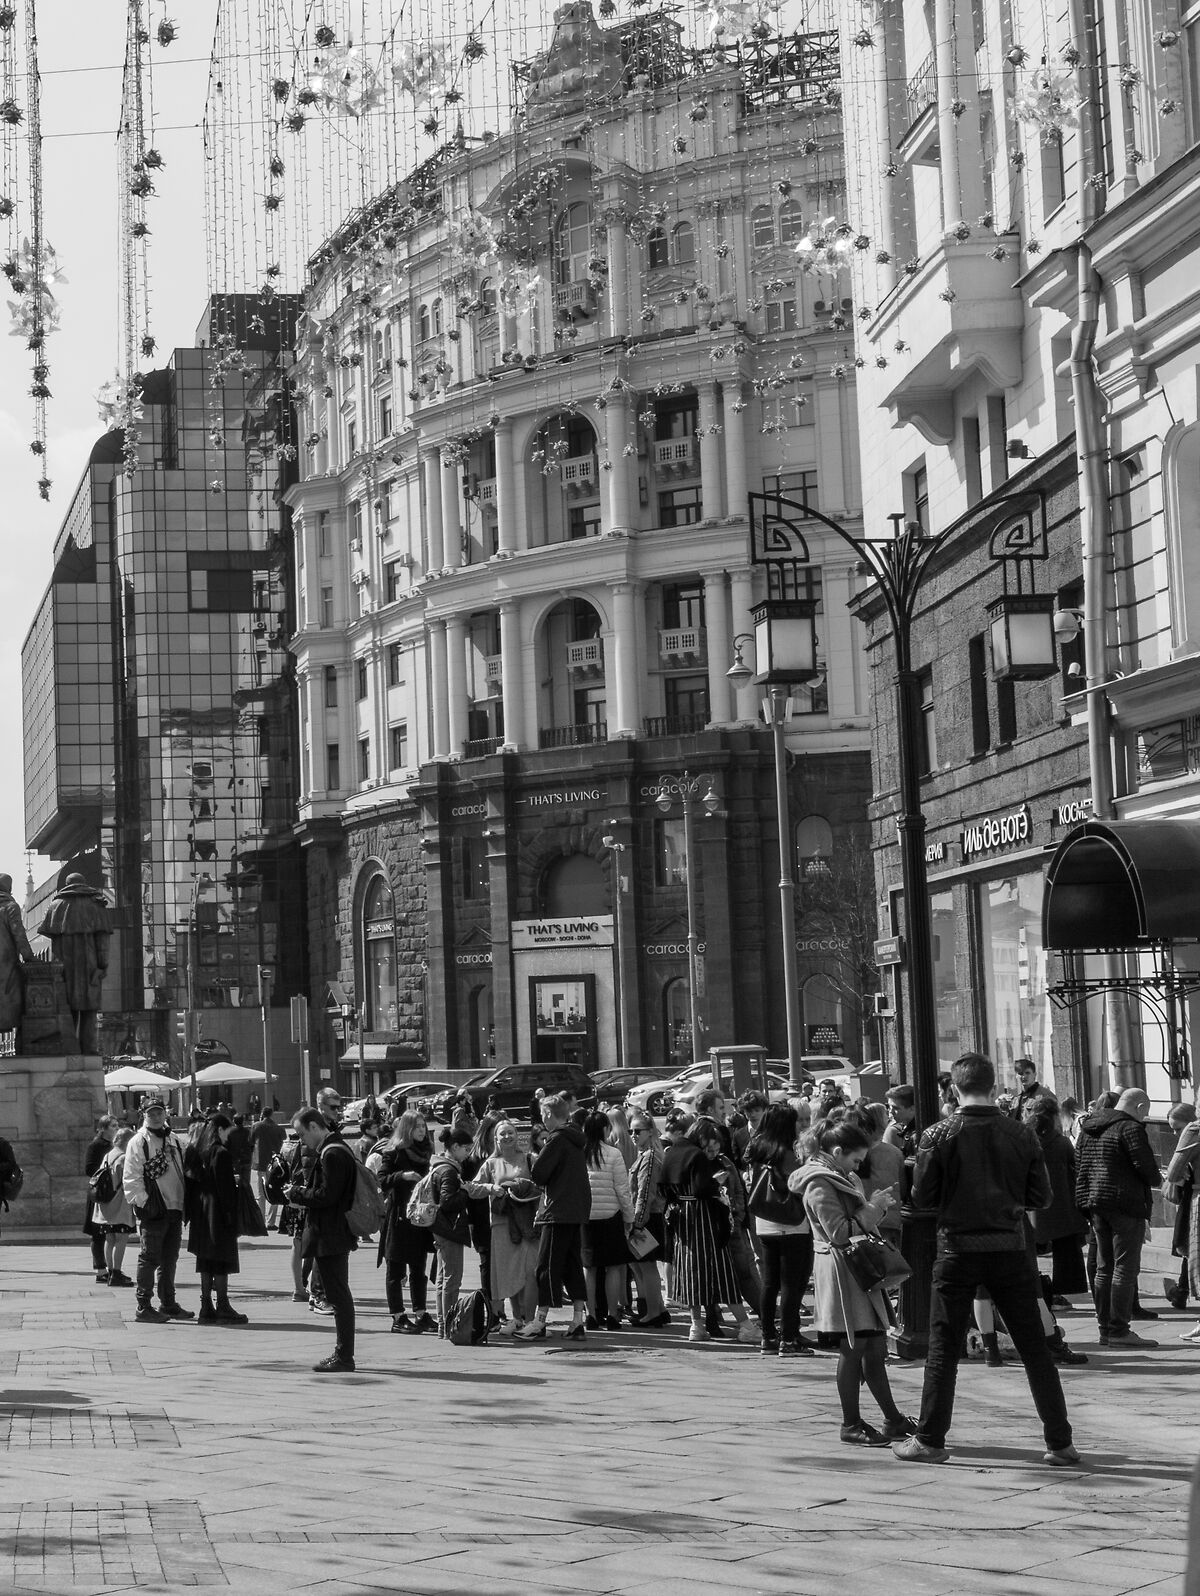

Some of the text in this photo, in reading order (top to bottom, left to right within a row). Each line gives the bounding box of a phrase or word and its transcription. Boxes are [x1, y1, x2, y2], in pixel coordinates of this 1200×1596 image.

[528, 789, 600, 806] THAT'S LIVING
[965, 827, 982, 854] ИЛЬ
[527, 922, 599, 936] THAT'S LIVING
[646, 943, 706, 955] carace
